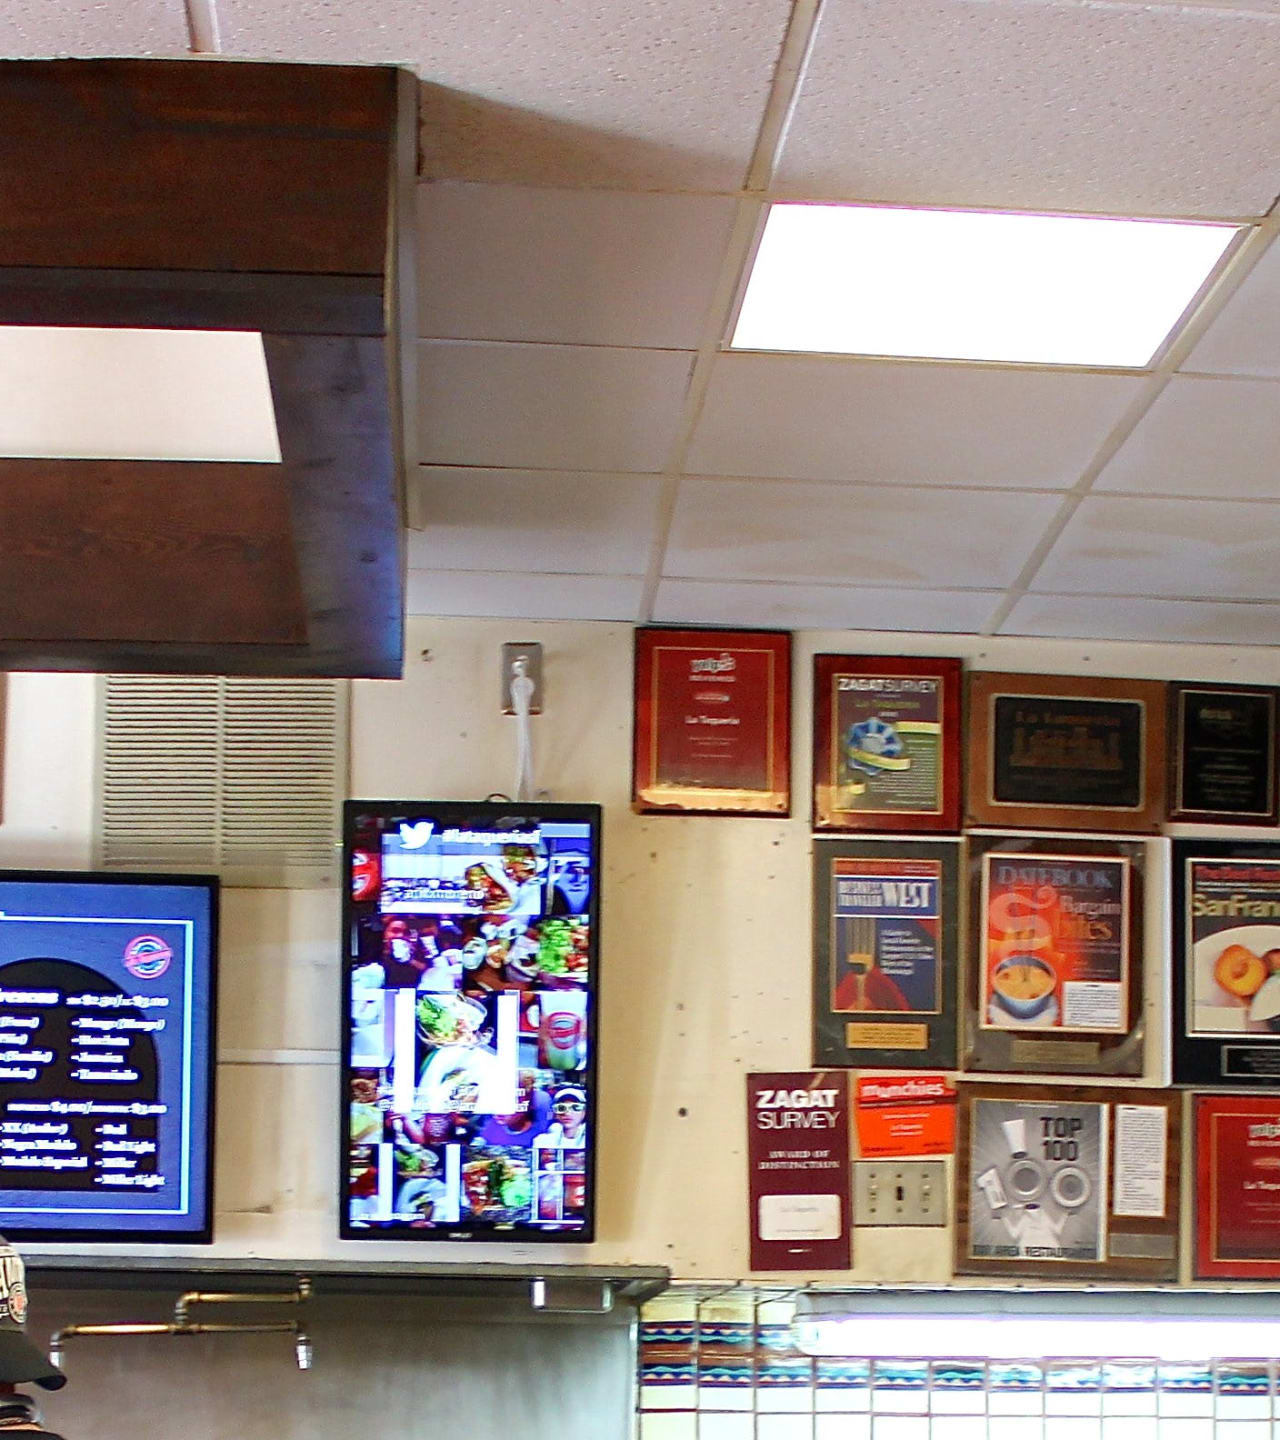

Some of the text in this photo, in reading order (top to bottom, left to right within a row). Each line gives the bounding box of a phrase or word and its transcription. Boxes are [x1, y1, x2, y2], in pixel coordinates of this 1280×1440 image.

[755, 1088, 840, 1109] ZAGAT
[756, 1110, 841, 1130] SURVEY
[1040, 1117, 1084, 1139] TOP
[1043, 1141, 1079, 1162] 100
